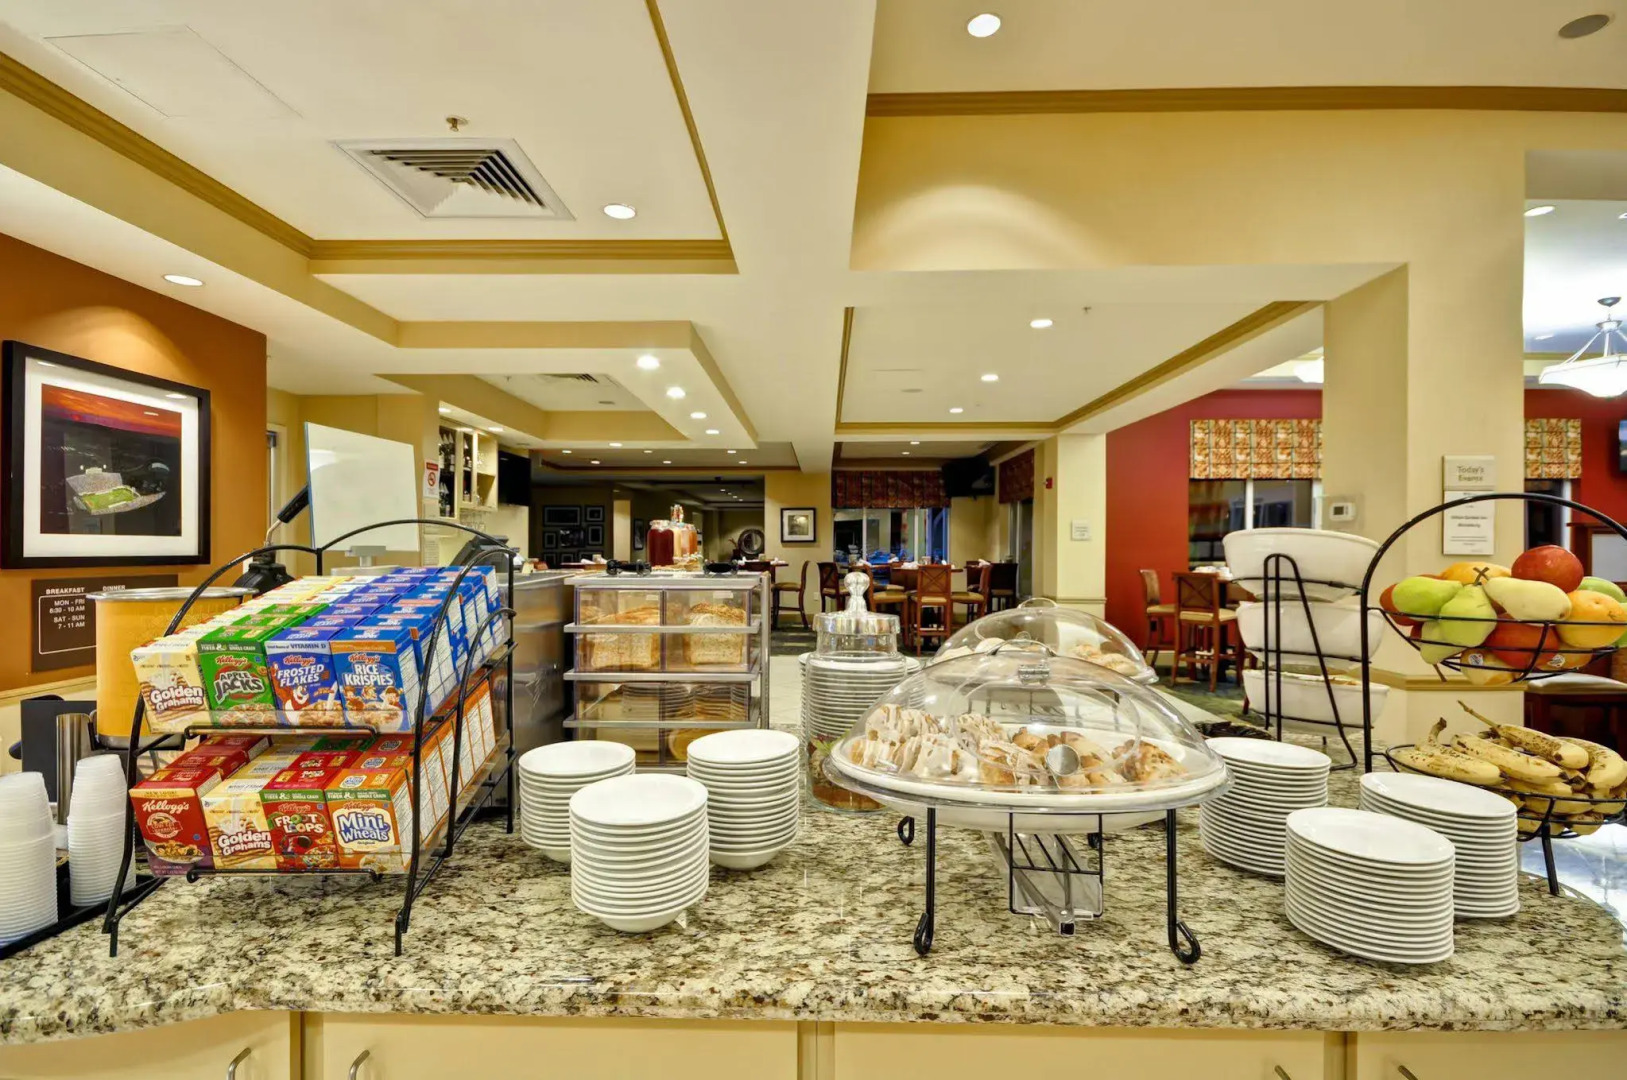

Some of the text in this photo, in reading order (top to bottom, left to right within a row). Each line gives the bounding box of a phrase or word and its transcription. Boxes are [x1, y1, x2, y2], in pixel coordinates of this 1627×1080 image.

[1457, 466, 1484, 474] Today's
[45, 587, 85, 595] BREAKFAST
[215, 655, 248, 666] Kellogg's
[283, 655, 316, 666] Kellogg's
[348, 653, 380, 664] Kellogg's
[277, 664, 325, 680] FROSTED
[354, 664, 379, 675] RICE
[219, 672, 251, 681] APPLE
[280, 673, 320, 687] FLAKES
[343, 674, 394, 686] KRISPIES
[150, 686, 203, 704] Golden
[214, 677, 265, 704] JACKS
[155, 697, 203, 712] Grahams
[142, 800, 190, 814] Kellogg's
[278, 803, 311, 813] Kellogg's
[342, 801, 376, 811] Kellogg's
[275, 813, 318, 828] FROOT
[338, 811, 386, 832] Mini
[284, 823, 324, 833] LOOPS
[218, 831, 272, 849] Golden
[340, 828, 389, 844] Wheats
[222, 840, 272, 856] Grahams
